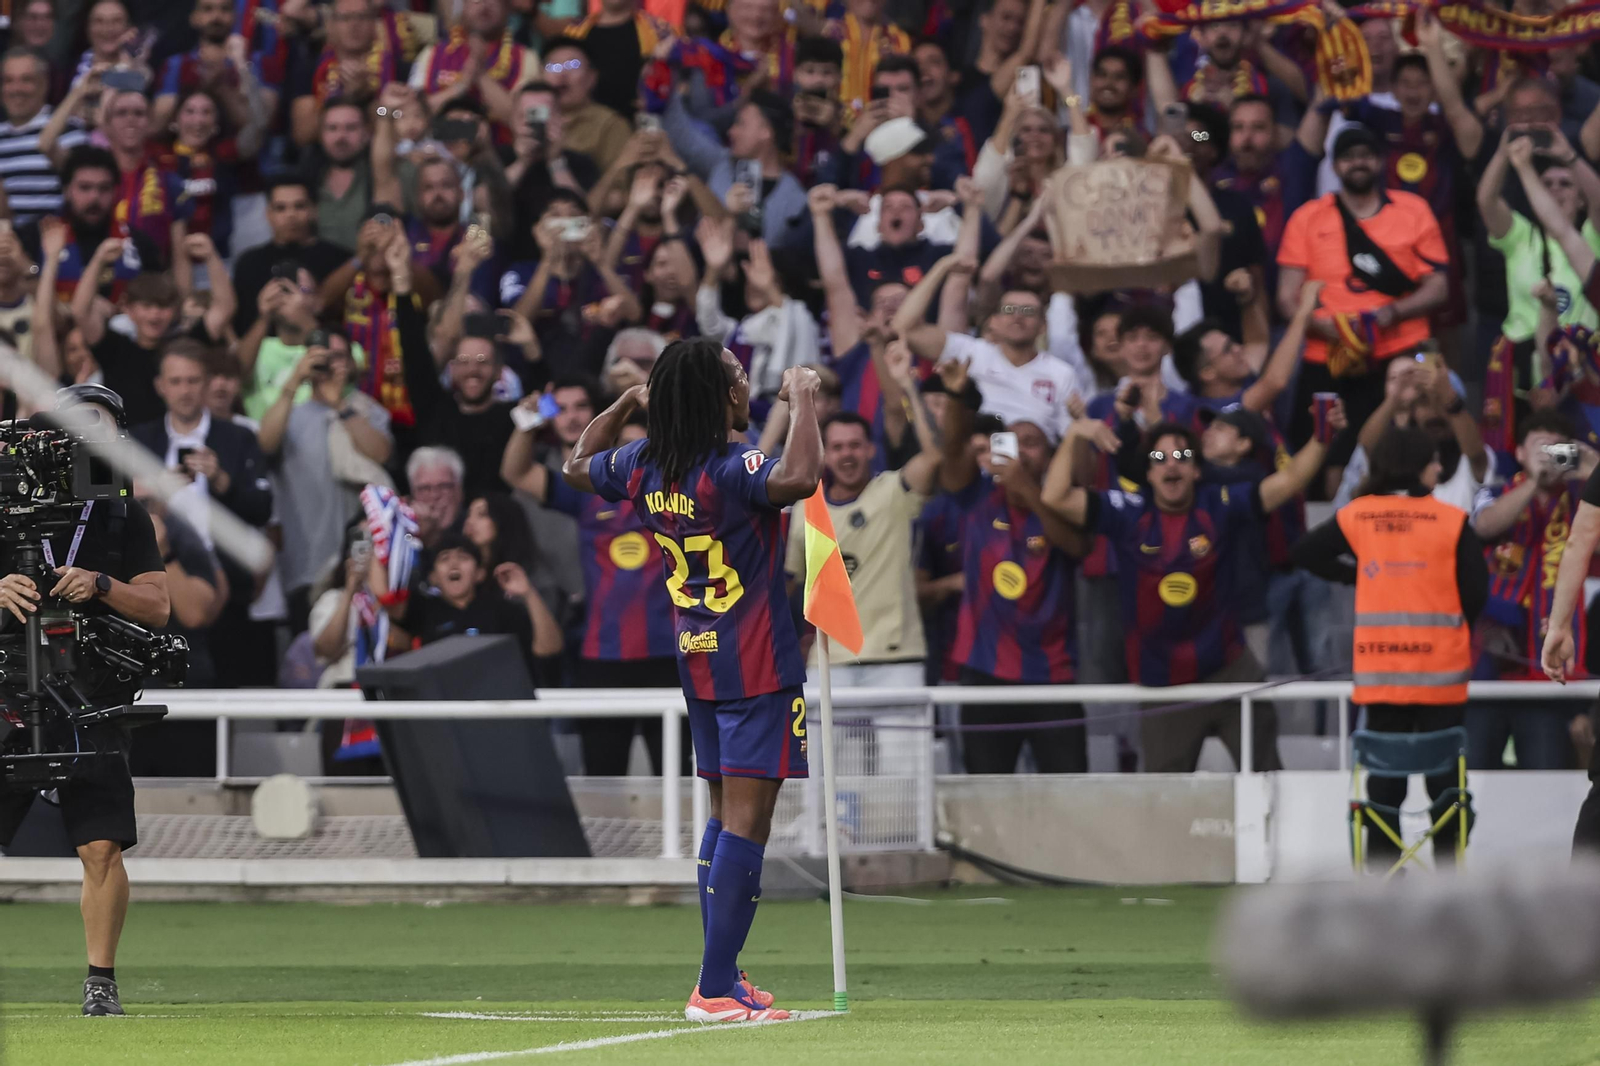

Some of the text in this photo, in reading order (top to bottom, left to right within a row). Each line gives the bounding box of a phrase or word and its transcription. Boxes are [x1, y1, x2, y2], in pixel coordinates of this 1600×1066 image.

[644, 490, 695, 520] KOUNDE
[653, 532, 745, 613] 23
[690, 639, 719, 650] ACNUR
[1357, 641, 1434, 654] STEWARD
[791, 696, 806, 737] 2
